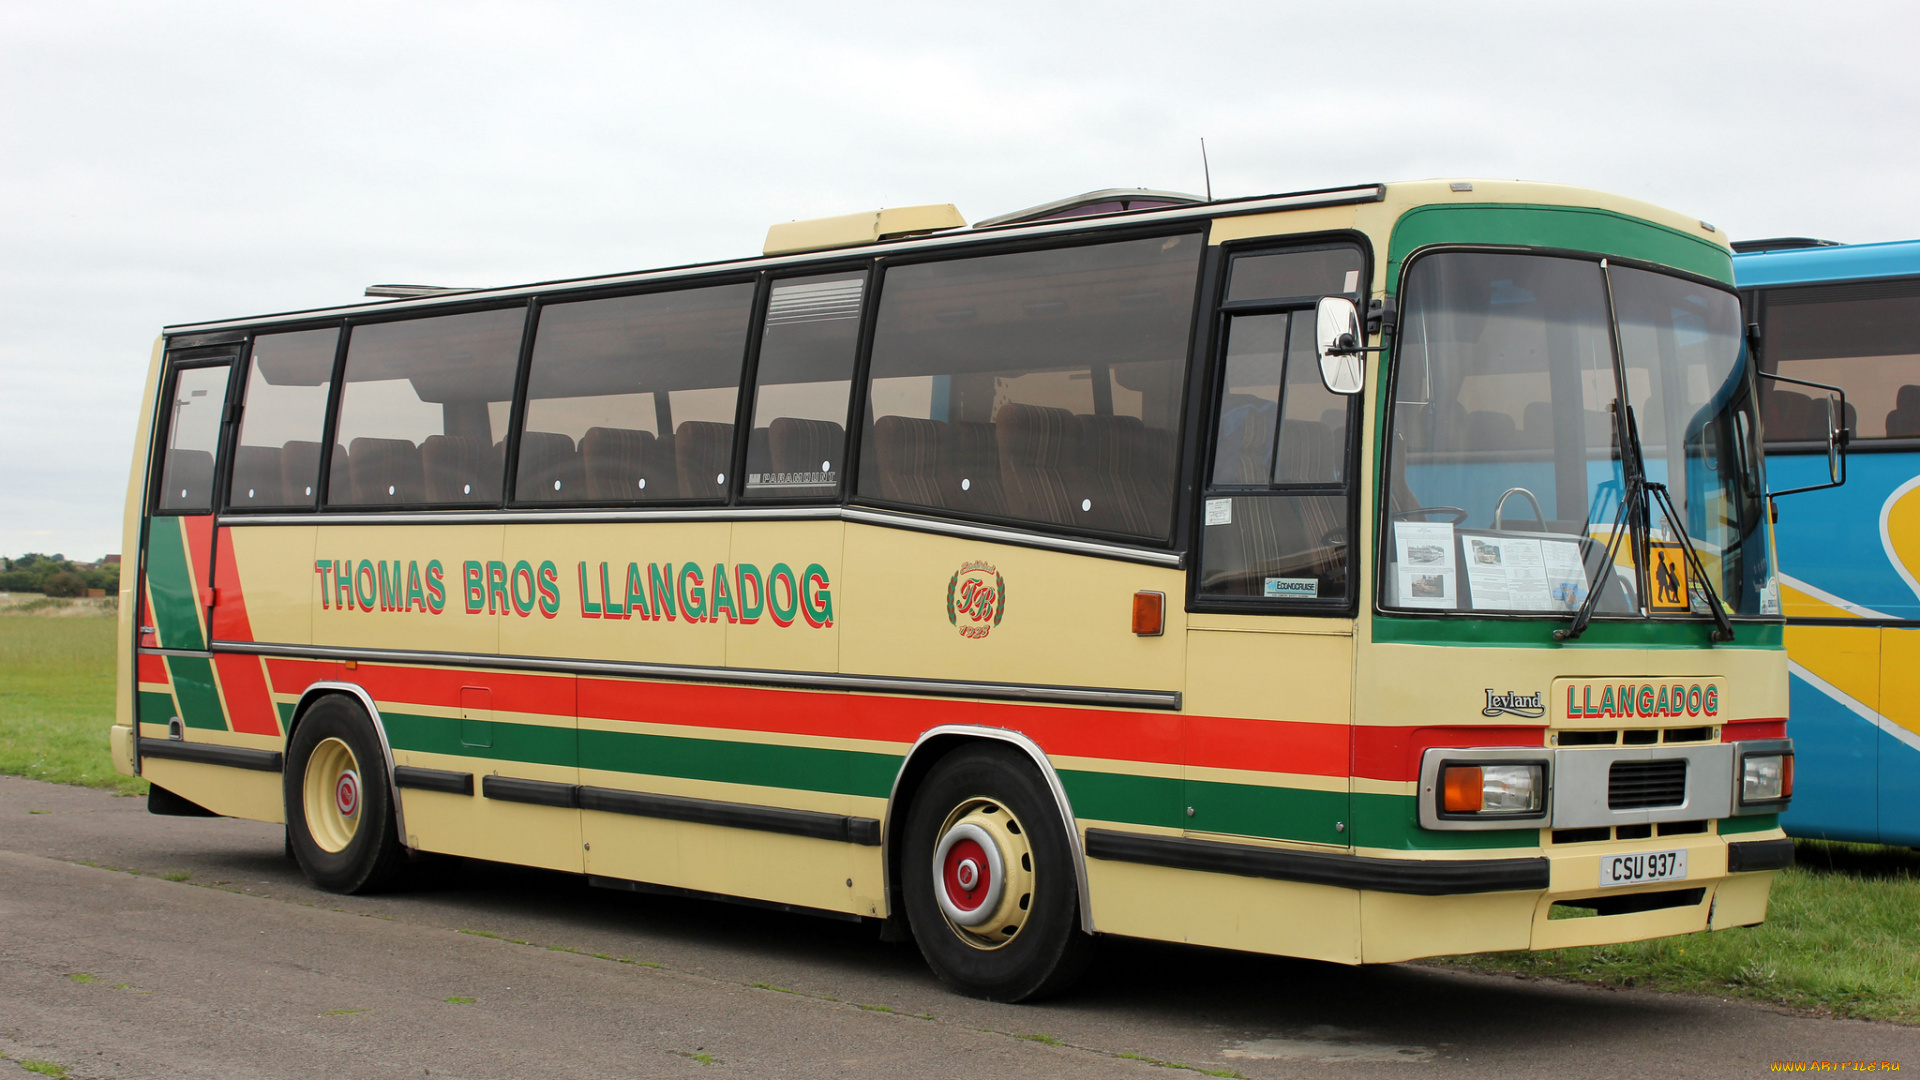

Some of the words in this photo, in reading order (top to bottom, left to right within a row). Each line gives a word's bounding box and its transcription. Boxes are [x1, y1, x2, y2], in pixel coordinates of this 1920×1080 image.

[762, 471, 836, 483] PARAMOUNT
[314, 559, 447, 615] THOMAS
[462, 560, 561, 619] BROS
[578, 561, 834, 629] LLANGADOG
[1482, 688, 1546, 718] Leyland
[1566, 683, 1719, 719] LLANGADOG
[1612, 856, 1644, 881] CSU
[1648, 852, 1676, 877] 937
